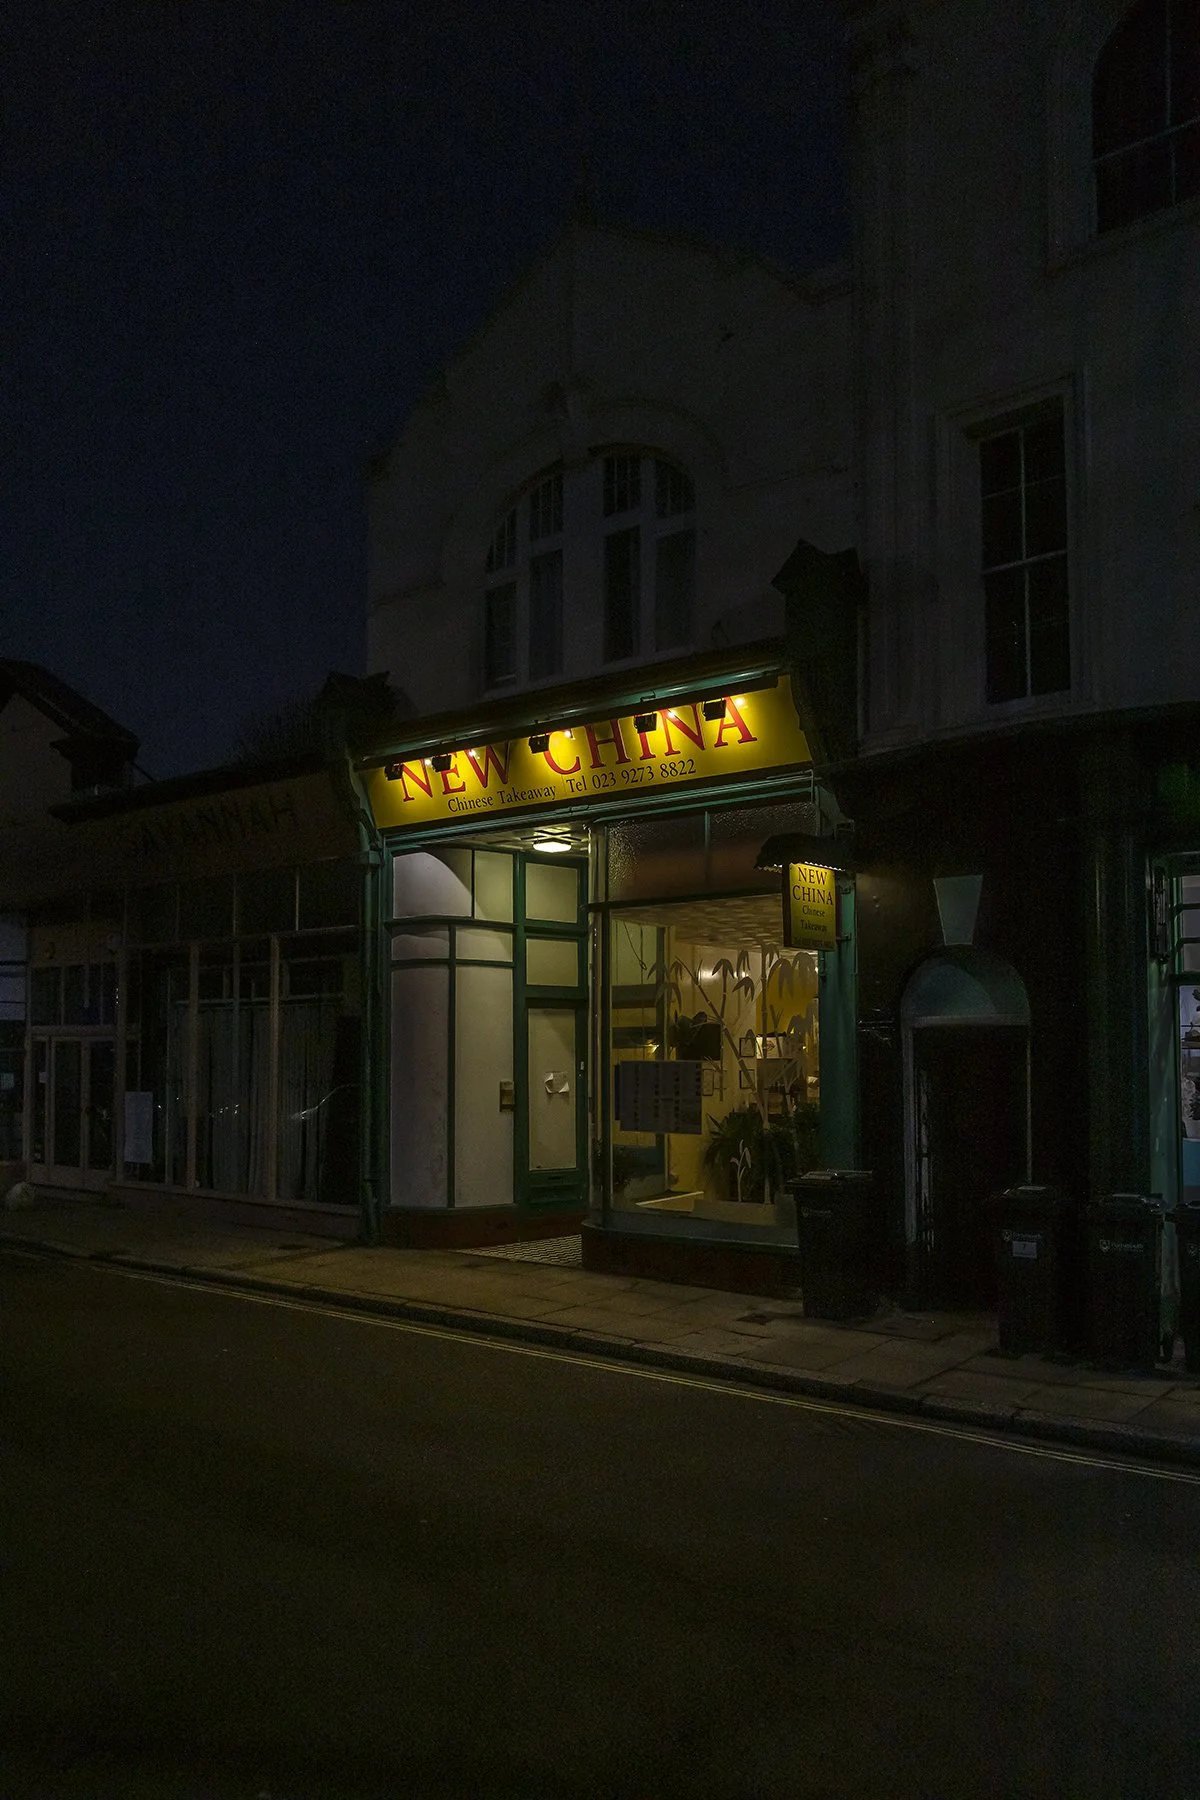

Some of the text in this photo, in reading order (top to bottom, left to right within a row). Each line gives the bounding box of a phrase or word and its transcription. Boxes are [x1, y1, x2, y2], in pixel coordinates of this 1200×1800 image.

[402, 695, 758, 802] NEW CHINA
[447, 758, 697, 813] Chinese Takeaway Tel 023 9273 8822
[798, 868, 827, 885] NEW
[792, 885, 834, 905] CHINA
[802, 905, 825, 917] Chinese
[801, 919, 827, 933] Takeaway
